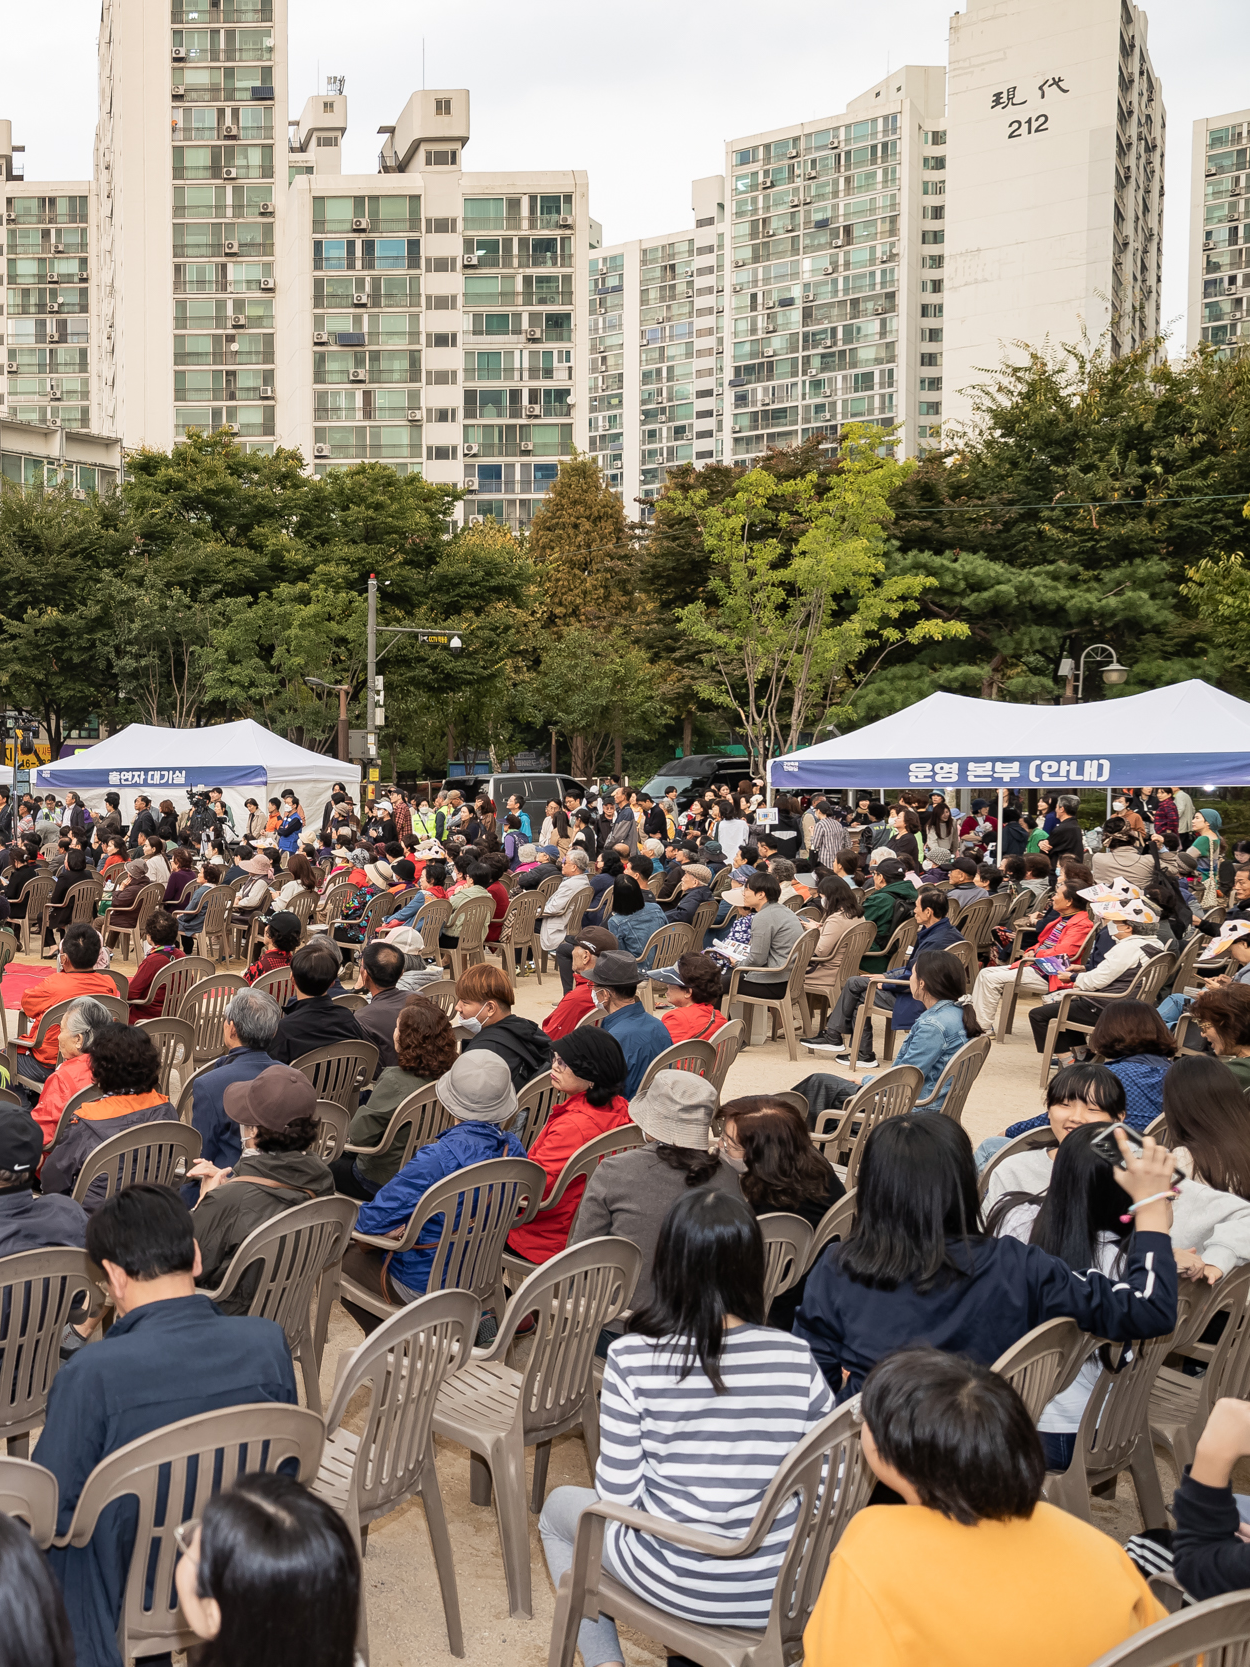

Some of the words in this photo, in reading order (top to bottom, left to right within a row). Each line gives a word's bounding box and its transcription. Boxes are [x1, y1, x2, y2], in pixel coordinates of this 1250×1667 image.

[991, 76, 1070, 109] 現代
[1007, 113, 1049, 139] 212
[428, 635, 438, 643] CCTV
[108, 771, 145, 785] 출연자
[147, 770, 186, 784] 대기실
[908, 760, 959, 783] 운영
[966, 760, 1021, 782] 본부
[1028, 759, 1111, 782] (안내)
